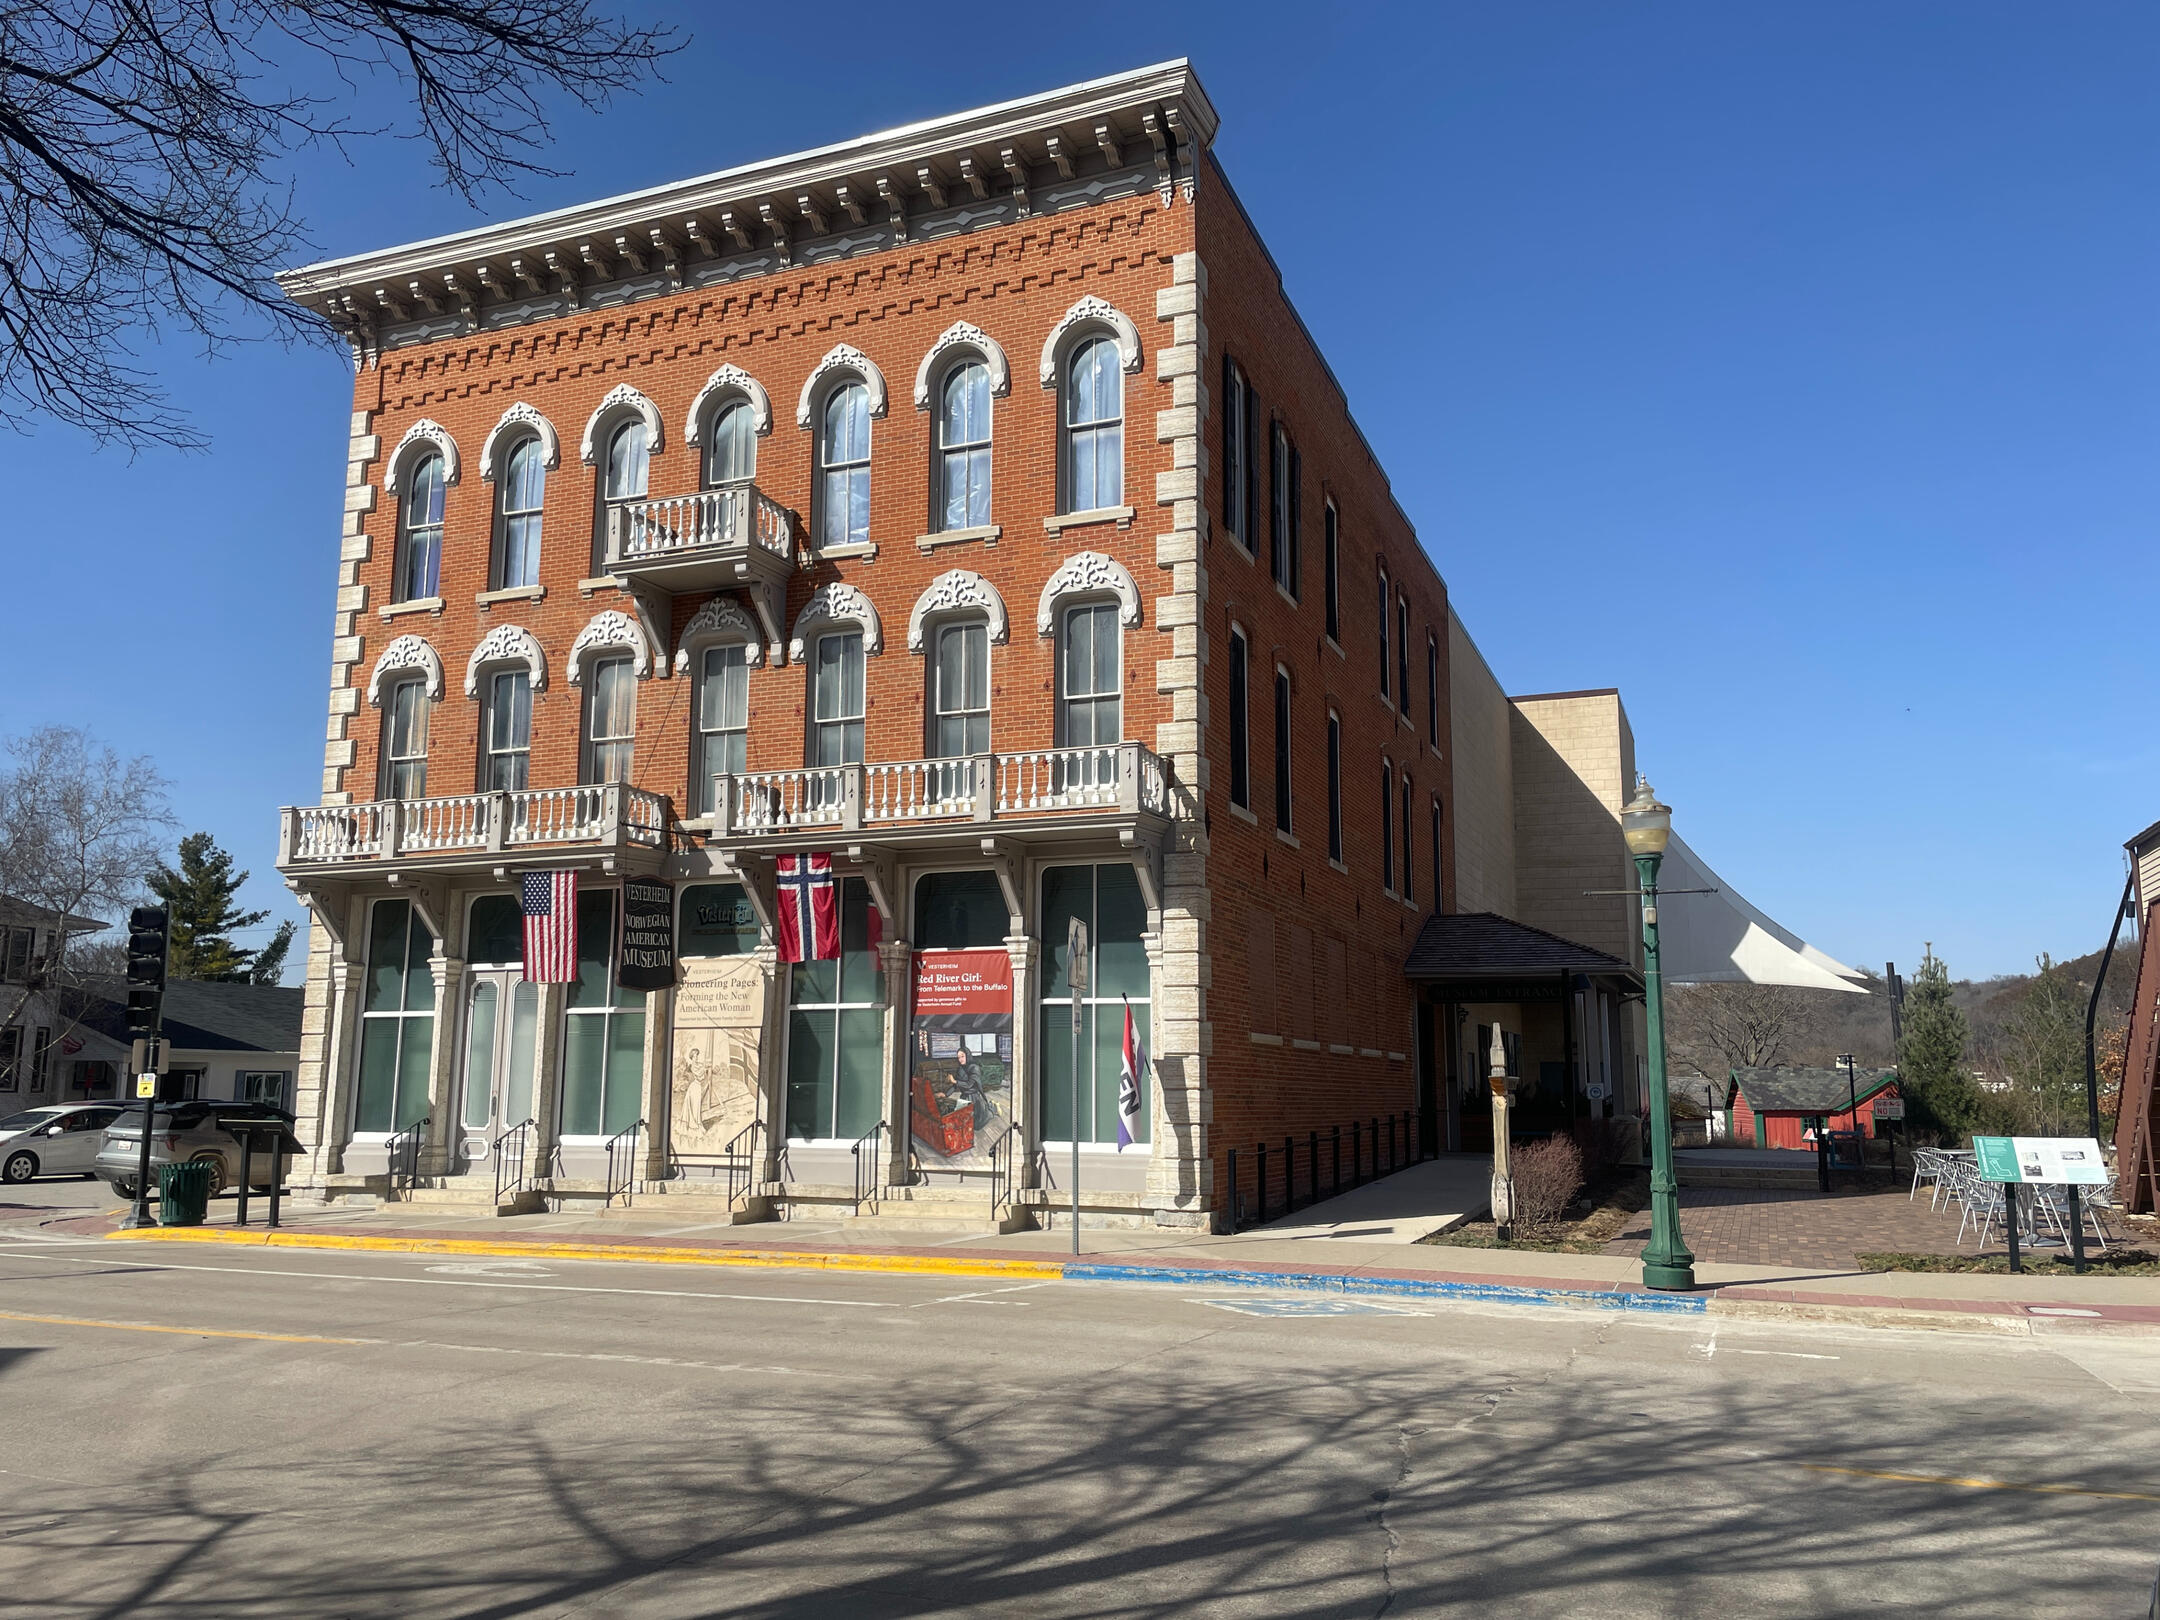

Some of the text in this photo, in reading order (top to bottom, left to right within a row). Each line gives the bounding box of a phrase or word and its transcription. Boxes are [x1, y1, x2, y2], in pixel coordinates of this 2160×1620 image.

[625, 884, 670, 903] VESTERHEIM
[625, 913, 670, 929] NORWEGIAN
[624, 931, 670, 946] AMERICAN
[623, 948, 671, 968] MUSEUM
[682, 978, 759, 990] Pioneering Pages:
[917, 972, 982, 984] Red River Girl:
[934, 984, 962, 992] Telemark
[984, 983, 1008, 991] Buffalo
[680, 991, 750, 1003] Forming the New
[679, 1002, 751, 1013] American Woman
[1877, 1107, 1888, 1115] NO
